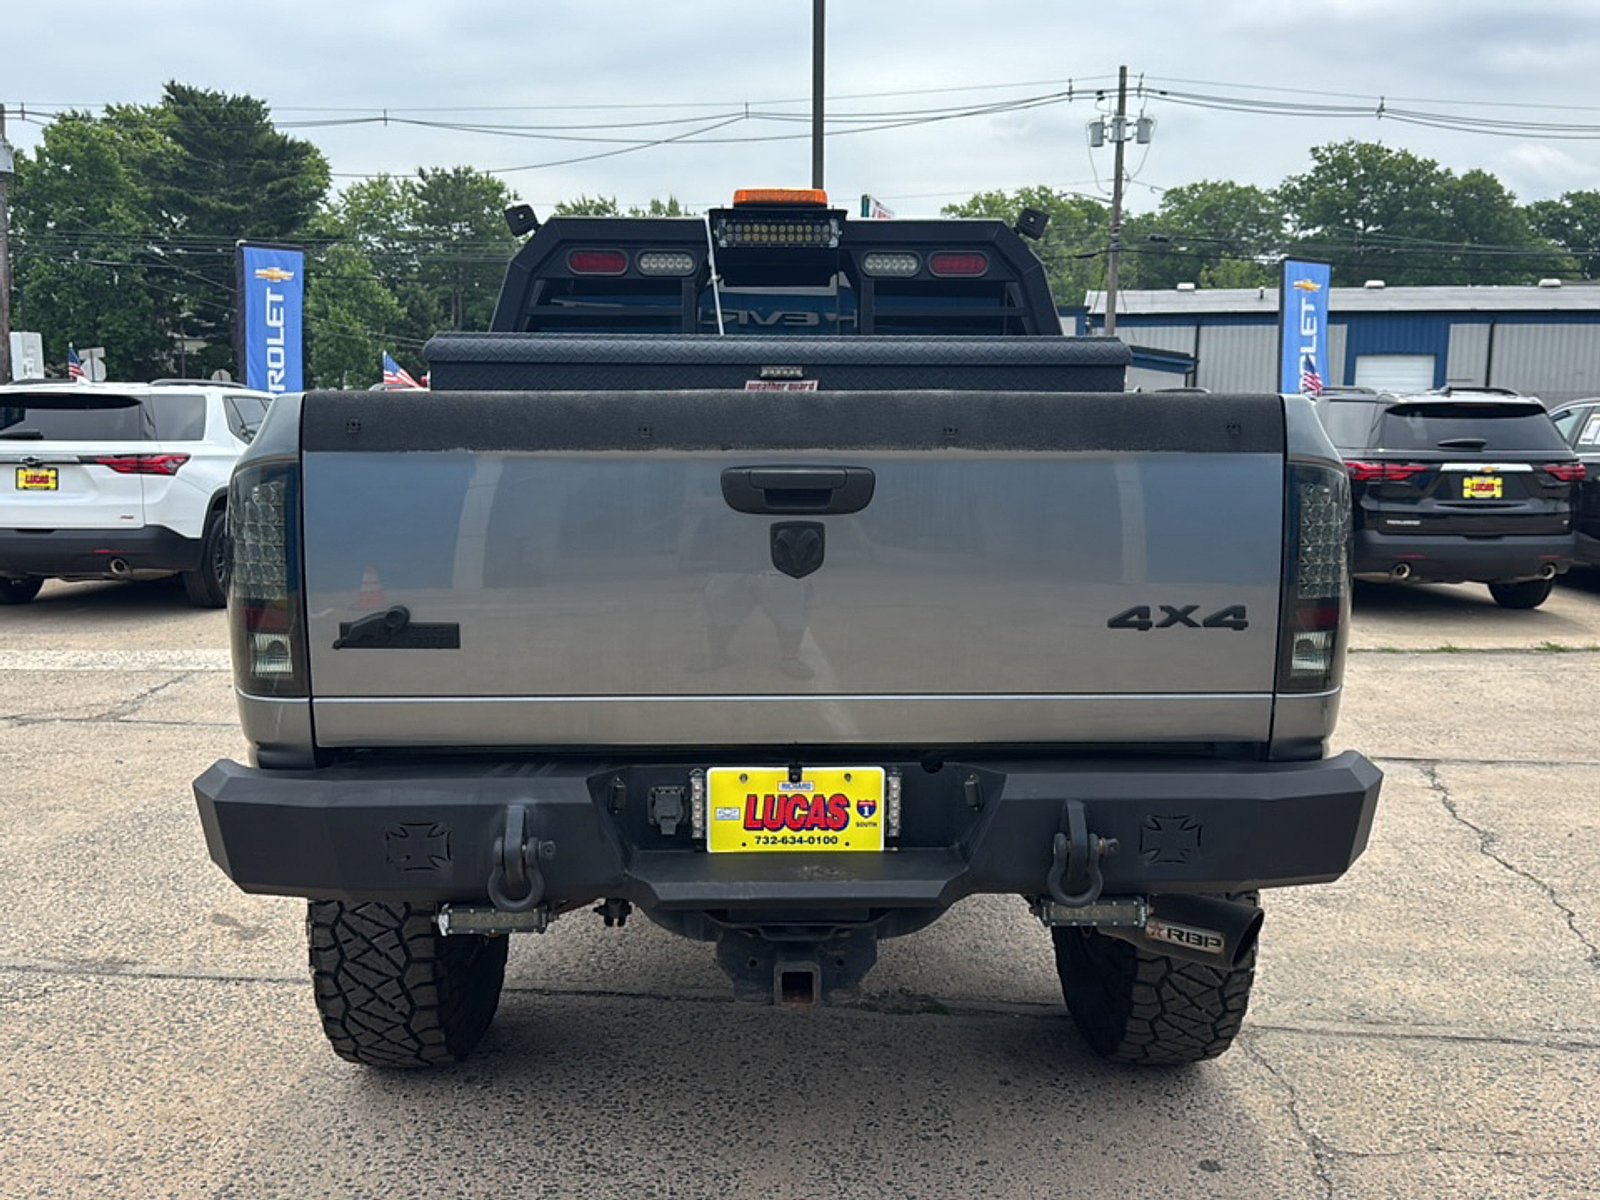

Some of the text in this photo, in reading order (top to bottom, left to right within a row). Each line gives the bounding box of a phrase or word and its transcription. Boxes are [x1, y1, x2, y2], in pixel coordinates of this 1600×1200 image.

[1107, 604, 1249, 631] 4X4
[744, 794, 850, 832] LUCAS
[755, 835, 839, 845] 732-634-0100
[1166, 927, 1222, 948] RBP
